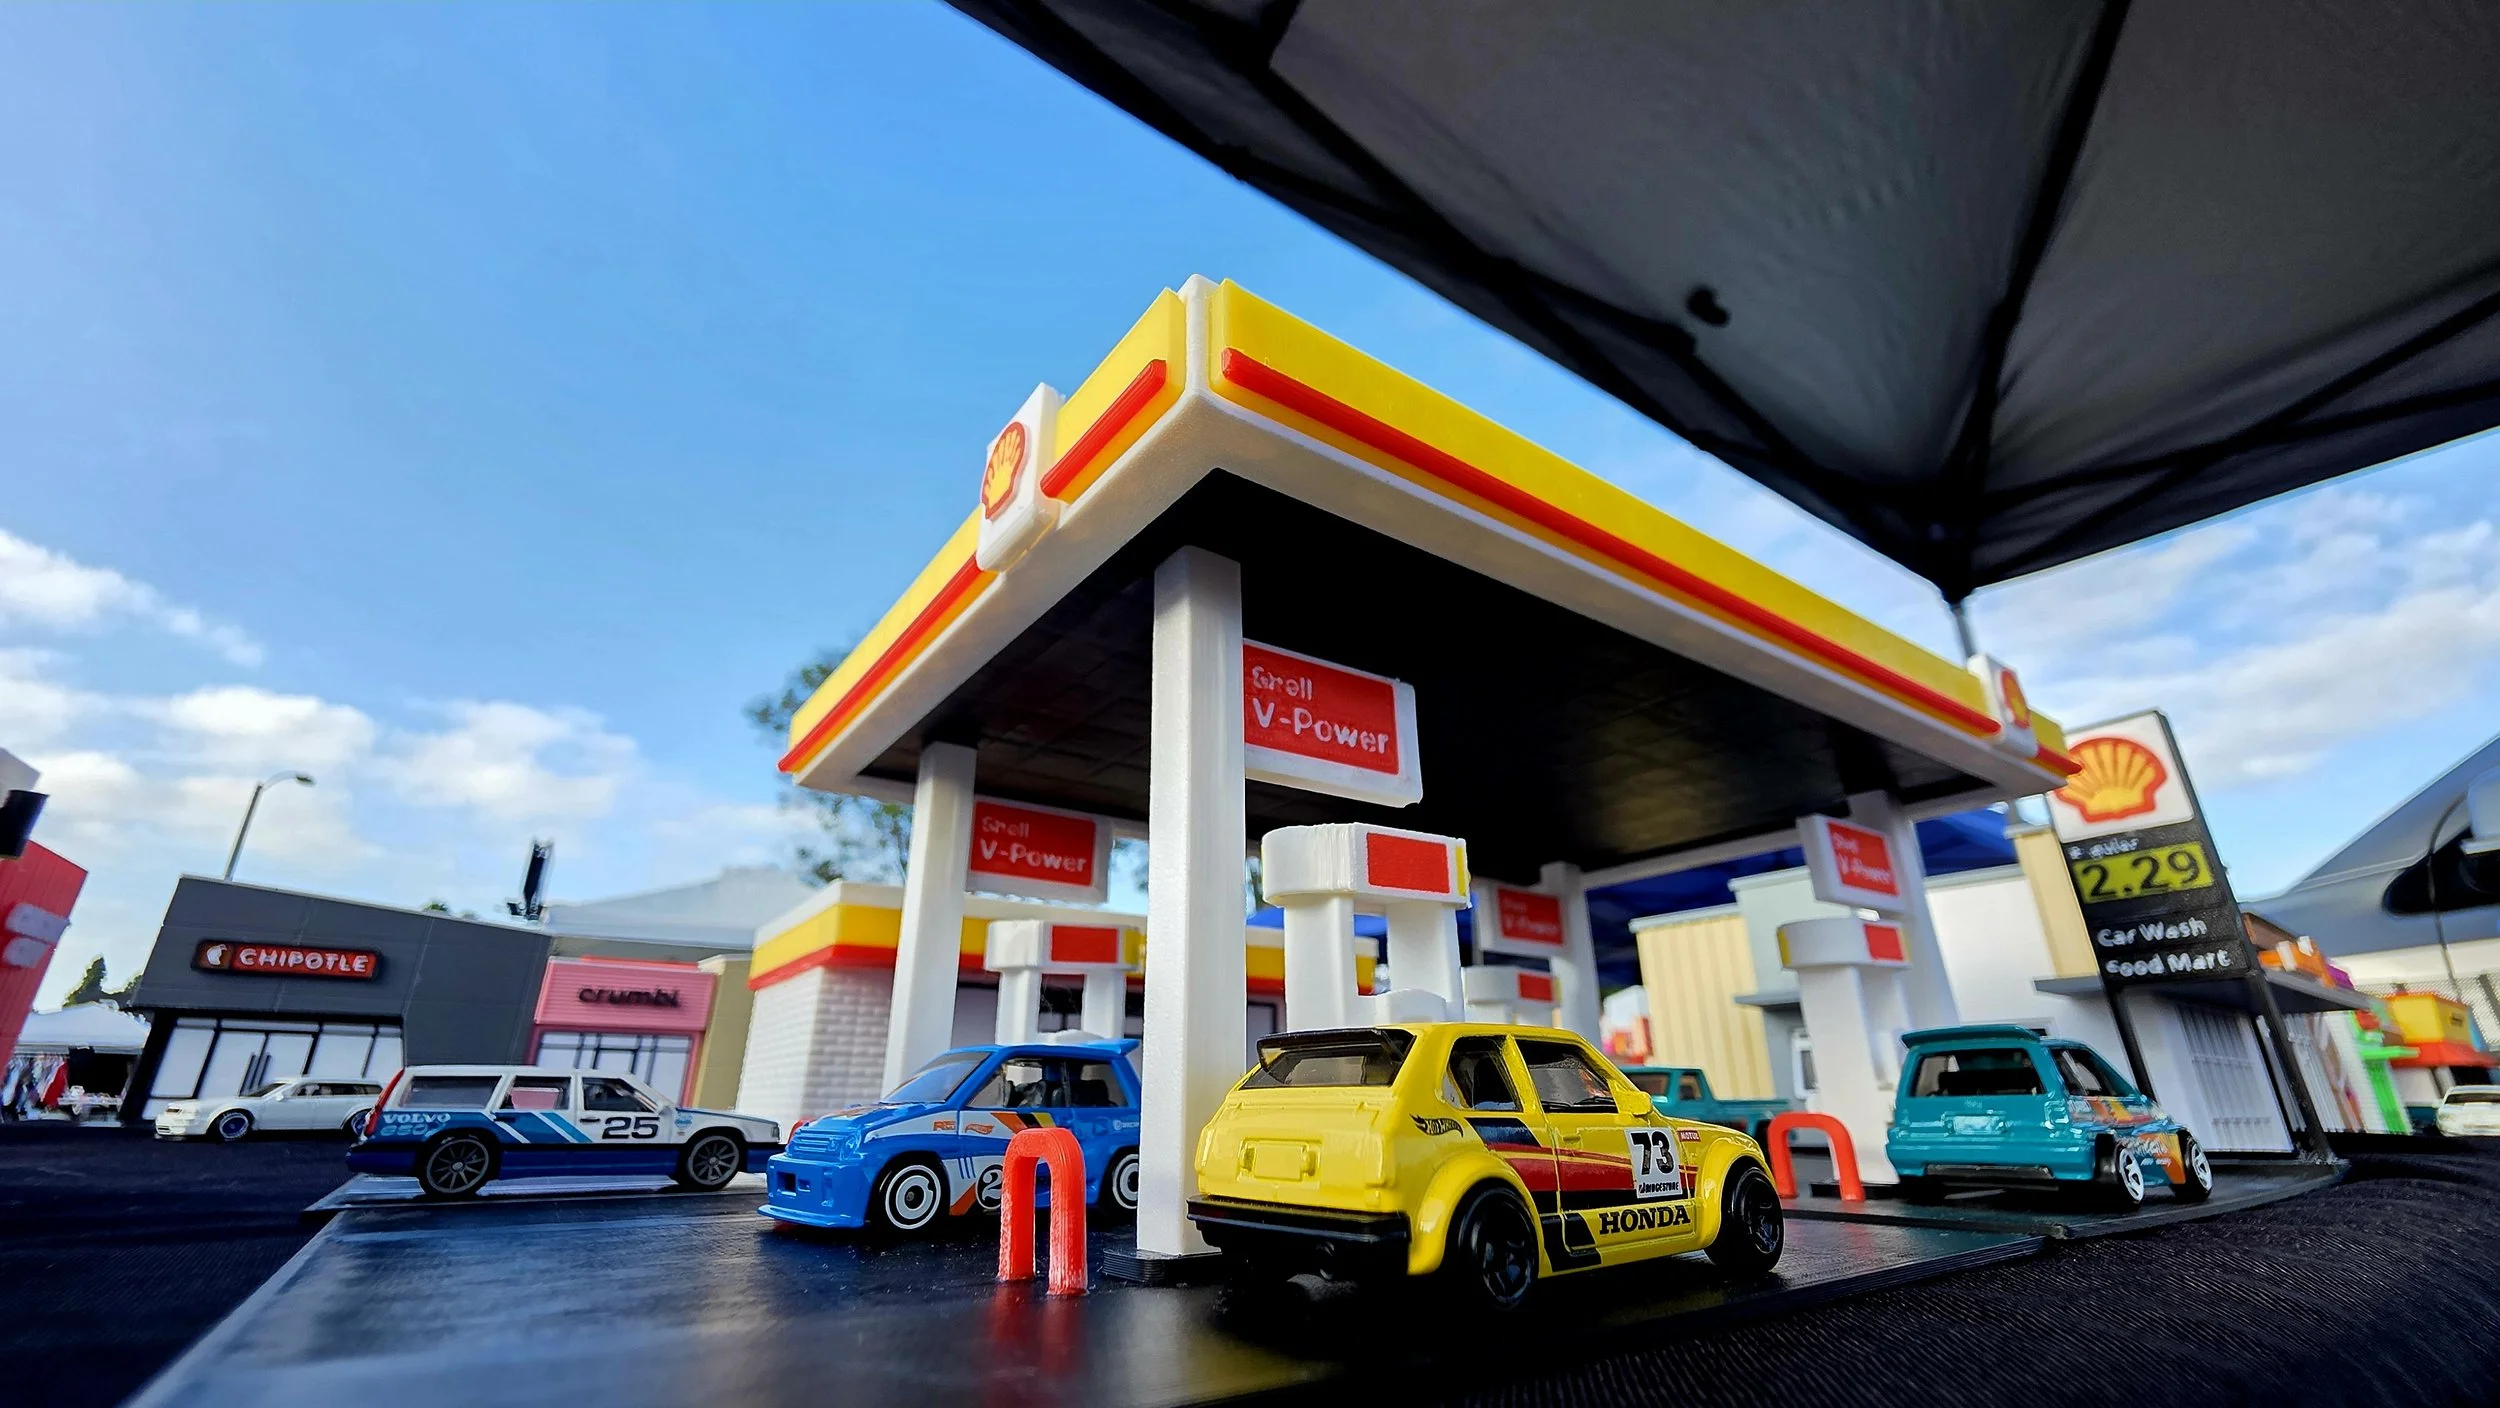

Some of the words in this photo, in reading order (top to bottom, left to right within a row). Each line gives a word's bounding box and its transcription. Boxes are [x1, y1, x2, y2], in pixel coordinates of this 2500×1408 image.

[1253, 697, 1388, 754] V-Power
[980, 838, 1086, 872] V-Power
[2082, 850, 2200, 898] 2.29
[2097, 928, 2137, 947] Car
[2138, 917, 2208, 942] Wash
[239, 948, 369, 972] CHIPOTLE
[2166, 949, 2232, 973] Mart
[382, 1113, 451, 1124] VOLVO
[602, 1116, 660, 1139] 25
[1630, 1130, 1676, 1176] 73
[1598, 1204, 1692, 1235] HONDA
